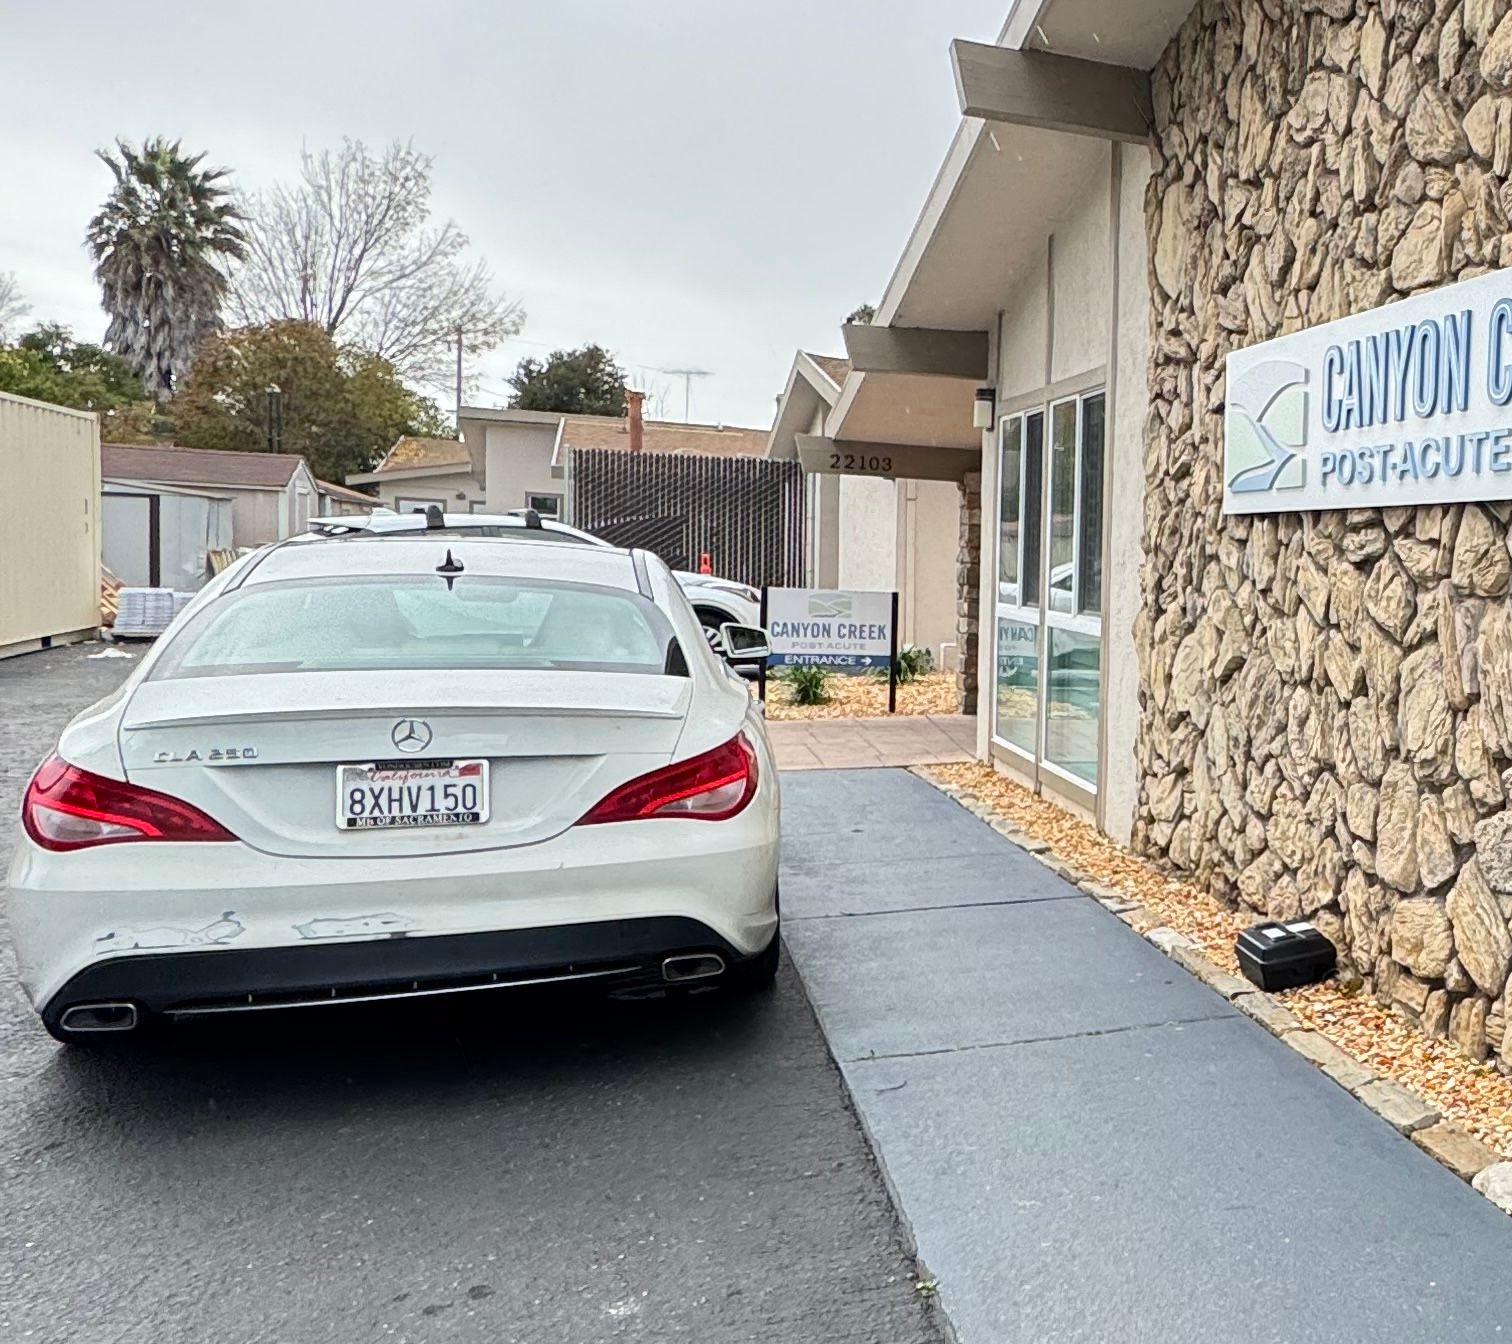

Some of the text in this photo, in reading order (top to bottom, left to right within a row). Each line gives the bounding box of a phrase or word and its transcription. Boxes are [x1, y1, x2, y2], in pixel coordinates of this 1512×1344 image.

[1321, 309, 1472, 433] CANYON
[829, 454, 892, 472] 22103
[1320, 427, 1512, 487] POST-ACUTE
[771, 621, 887, 641] CANYON CREEK
[784, 655, 857, 665] ENTRANCE
[370, 769, 452, 784] California
[350, 783, 478, 816] 8XHV150
[377, 816, 392, 826] OF
[395, 812, 473, 825] SACRAMENTO
